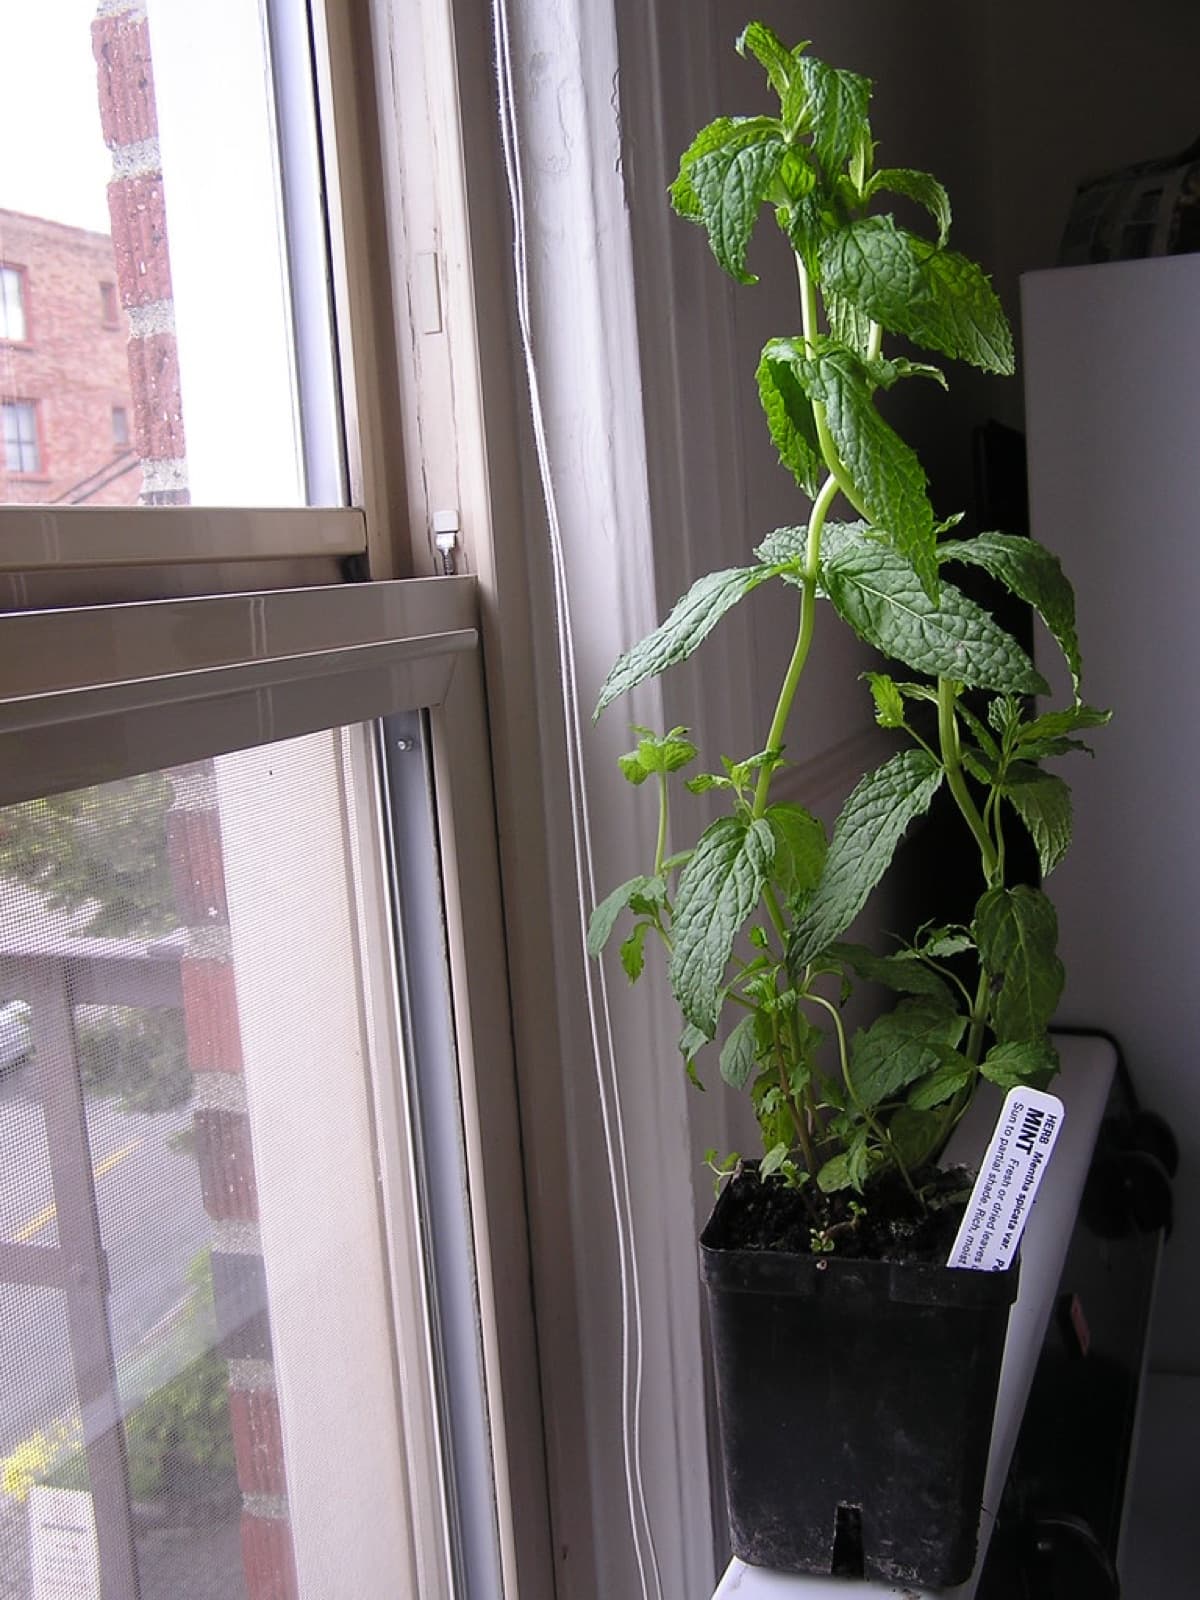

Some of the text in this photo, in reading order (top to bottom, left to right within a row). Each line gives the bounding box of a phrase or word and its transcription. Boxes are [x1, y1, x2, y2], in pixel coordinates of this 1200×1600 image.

[1010, 1102, 1024, 1123] Sun
[1005, 1125, 1014, 1136] to
[1039, 1114, 1057, 1145] HERB
[992, 1138, 1008, 1172] partial
[974, 1107, 1045, 1263] MINT Fresh or dried leaves
[1022, 1151, 1044, 1191] Mentha
[1008, 1193, 1026, 1230] spicata
[958, 1235, 974, 1264] moist
[1000, 1232, 1013, 1250] var.
